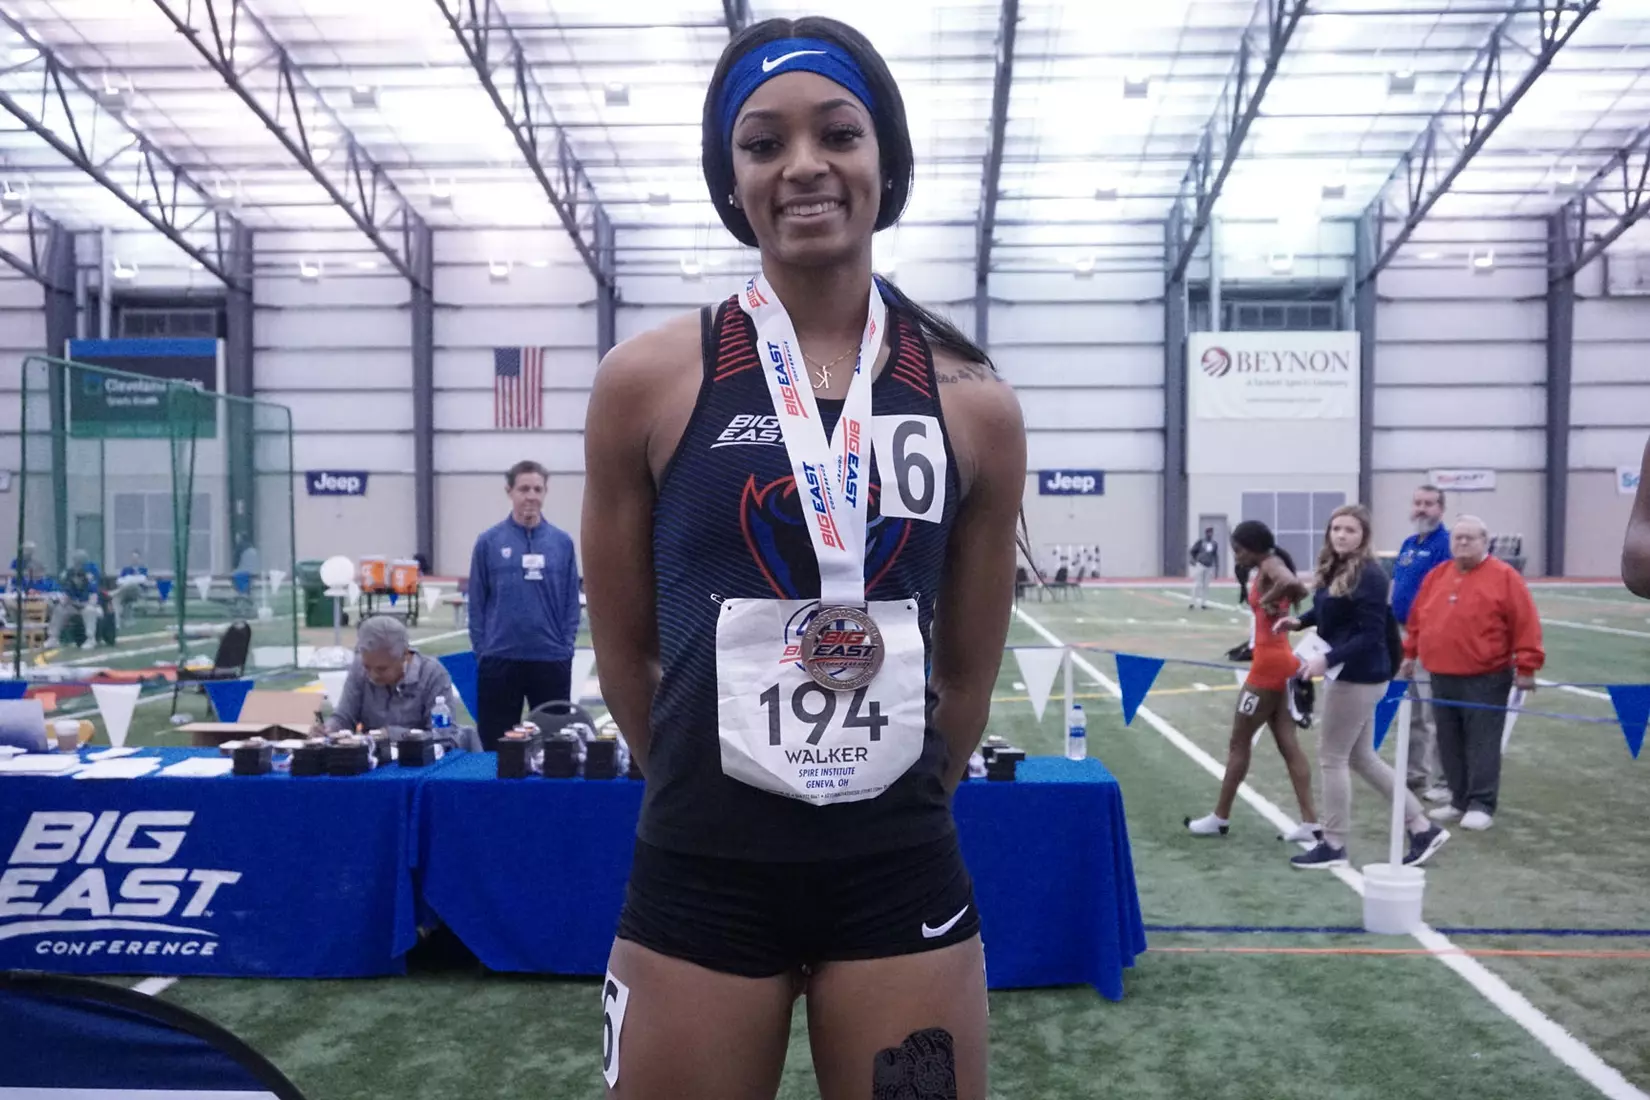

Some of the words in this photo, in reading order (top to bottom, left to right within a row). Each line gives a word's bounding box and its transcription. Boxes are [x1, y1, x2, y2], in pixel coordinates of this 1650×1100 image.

[766, 341, 791, 386] EAST
[1236, 350, 1351, 374] BEYNON
[780, 385, 800, 417] BIG
[727, 414, 779, 429] BIG
[716, 428, 785, 442] EAS
[849, 419, 861, 454] BIG
[891, 420, 936, 516] 6
[314, 473, 361, 493] Jeep
[802, 460, 827, 514] EAST
[845, 452, 860, 509] EAST
[1046, 471, 1096, 492] Jeep
[816, 512, 836, 548] BIG
[821, 631, 866, 645] BIG
[812, 644, 878, 657] EAST
[759, 681, 889, 746] 194
[1243, 696, 1255, 713] 6
[785, 746, 869, 765] WALKER
[798, 767, 819, 778] SPIRE
[820, 766, 855, 777] INSTITUTE
[806, 779, 837, 789] GENEVA,
[838, 778, 850, 788] OH
[7, 810, 195, 865] BIG
[0, 867, 243, 918] EAST
[35, 940, 220, 956] CONFERENCE
